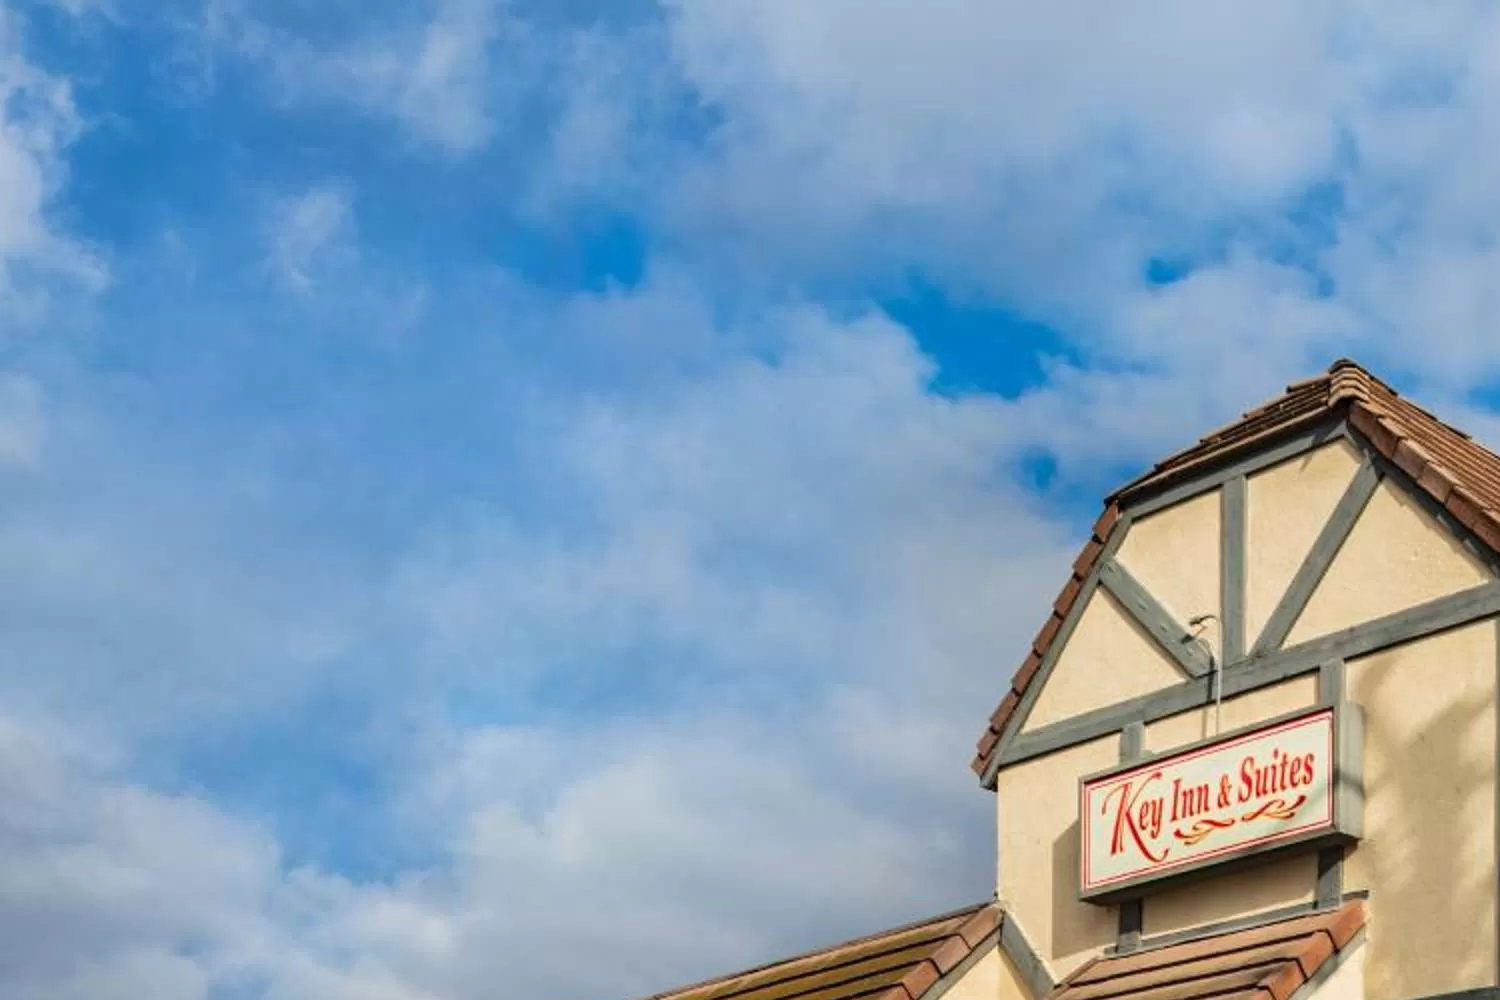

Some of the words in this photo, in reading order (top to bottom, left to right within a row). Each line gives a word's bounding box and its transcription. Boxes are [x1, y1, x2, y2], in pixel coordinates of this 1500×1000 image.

[1101, 771, 1169, 862] Key
[1170, 777, 1210, 823] Inn
[1216, 774, 1233, 807] &
[1237, 749, 1315, 803] Suites
